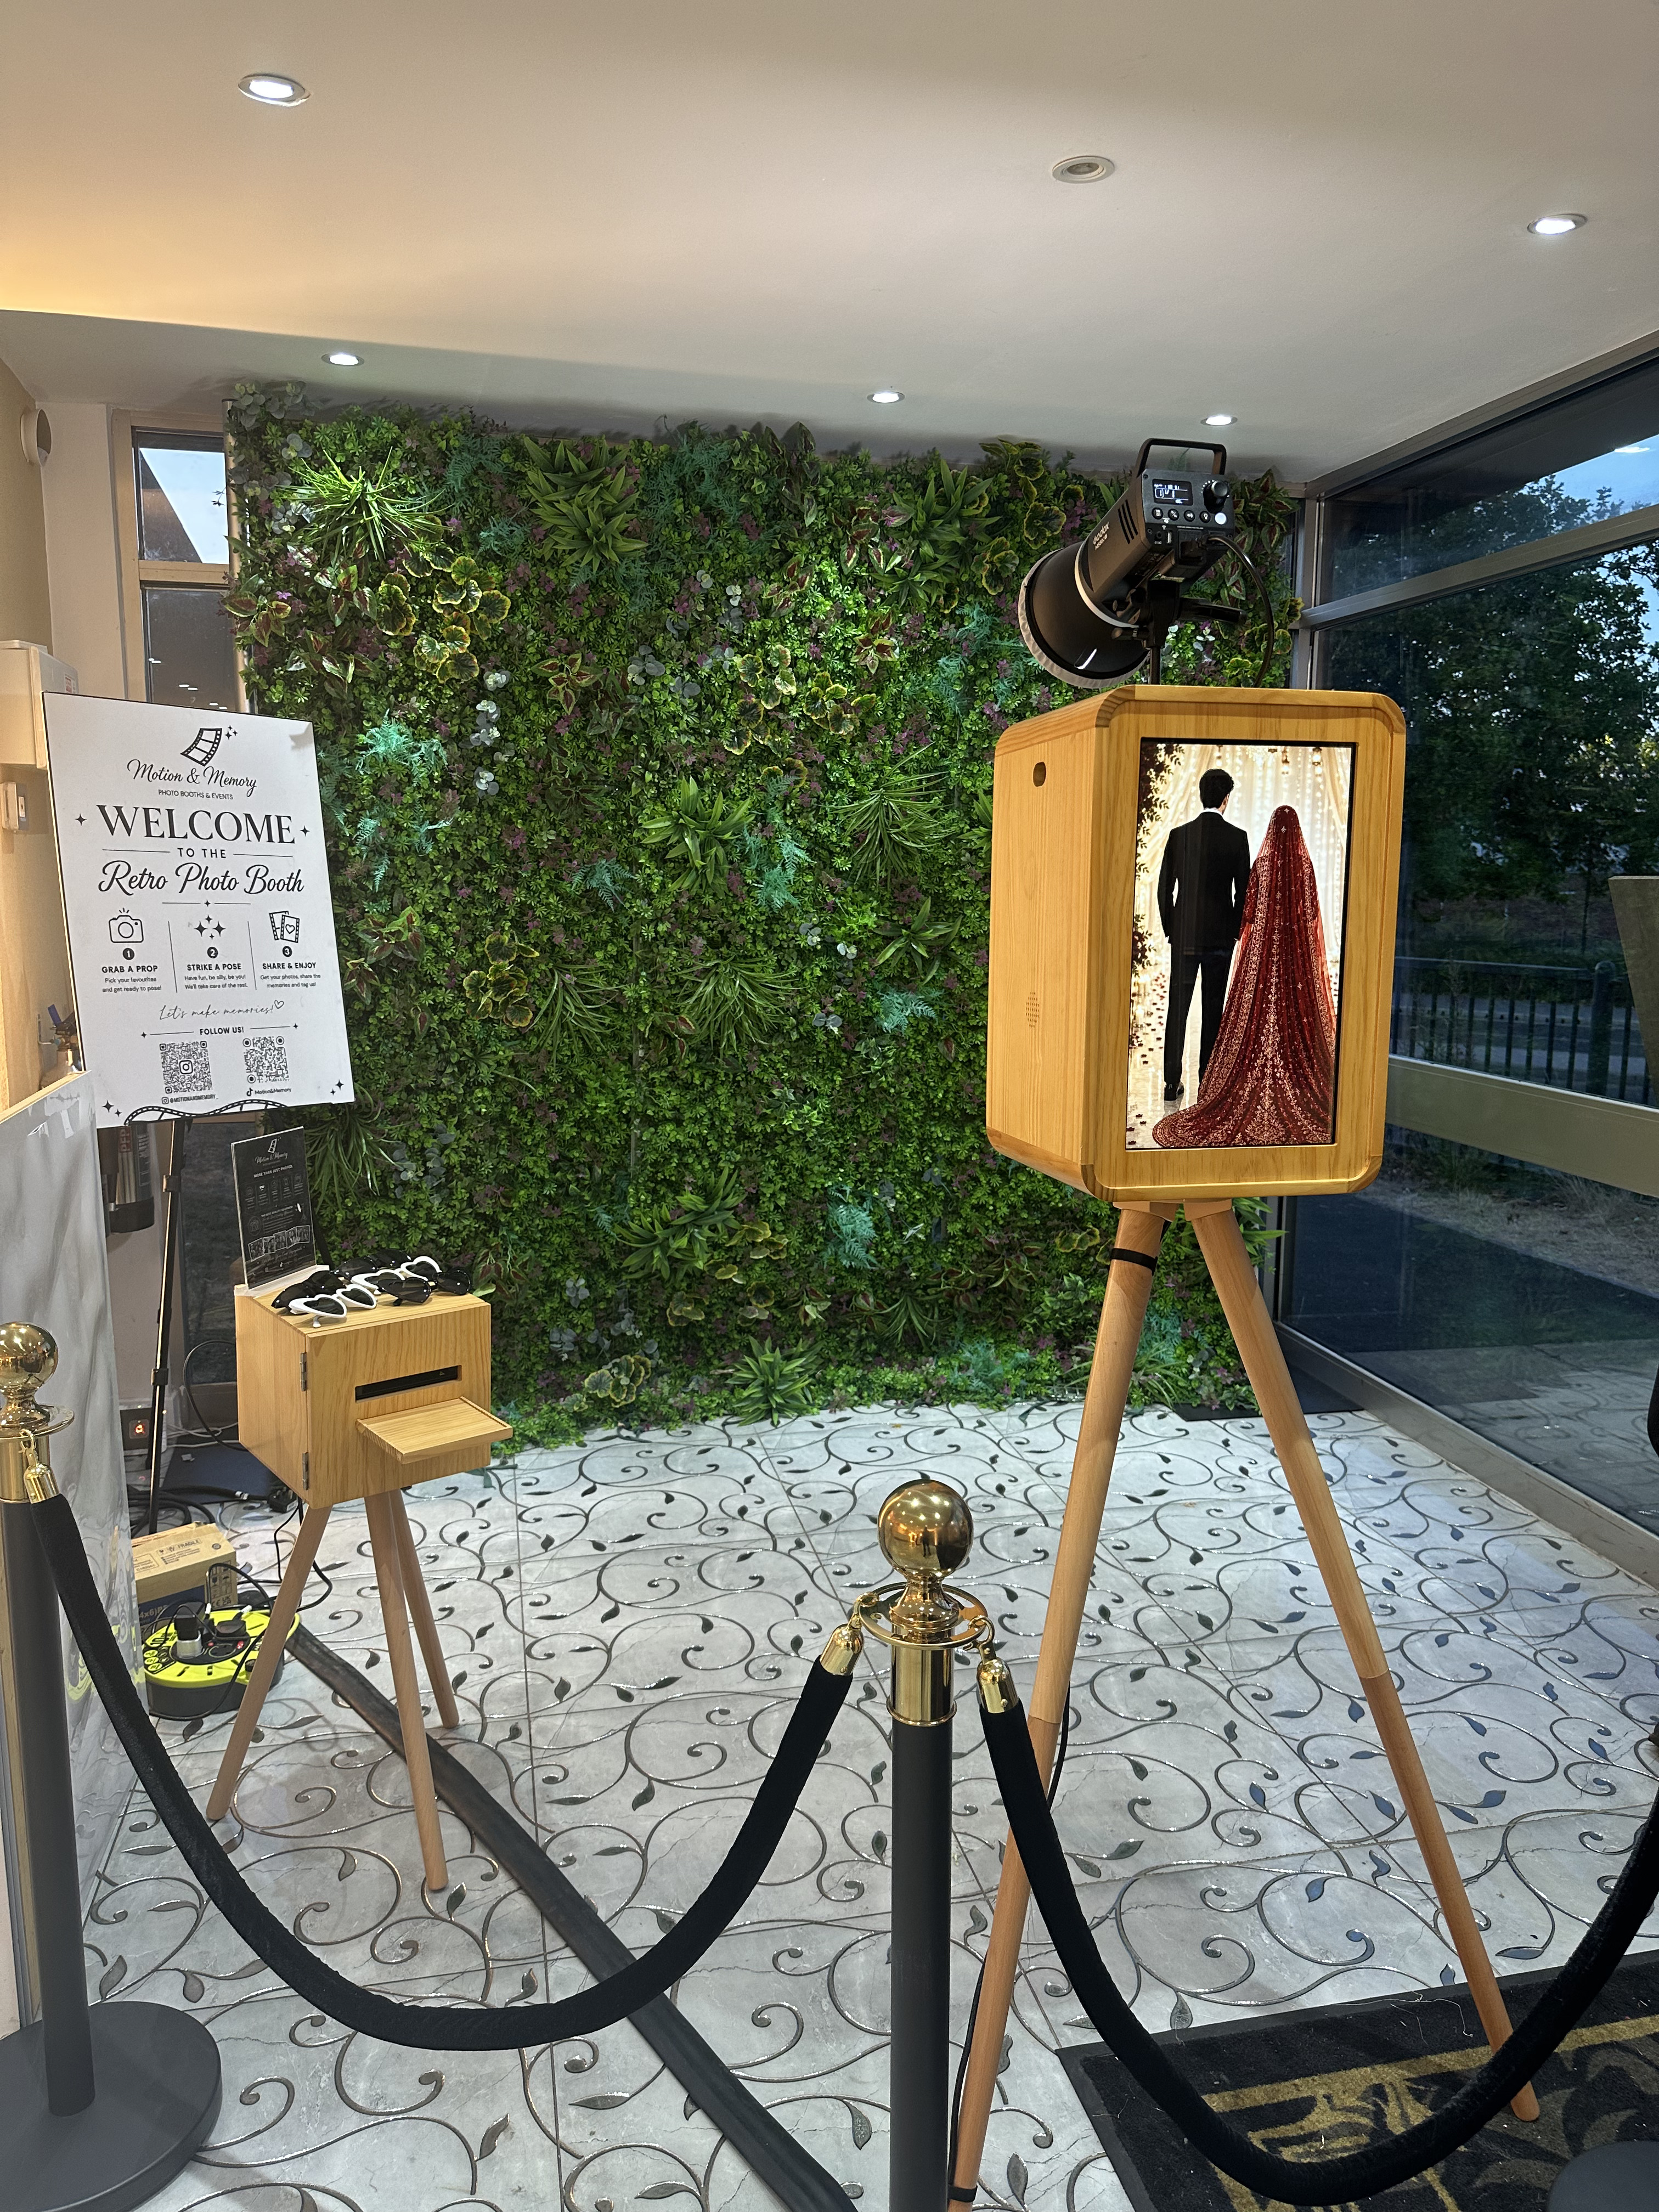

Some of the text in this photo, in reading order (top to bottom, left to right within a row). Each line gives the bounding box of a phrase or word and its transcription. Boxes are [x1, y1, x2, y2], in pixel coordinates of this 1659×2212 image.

[127, 759, 257, 798] Motion & Memory
[96, 804, 295, 844] WELCOME
[177, 847, 227, 859] TO THE
[98, 860, 304, 896] Retro Photo Booth
[159, 1003, 274, 1021] Let's make memories!
[199, 1026, 245, 1035] FOLLOW US!
[177, 1539, 199, 1548] FRAGILE
